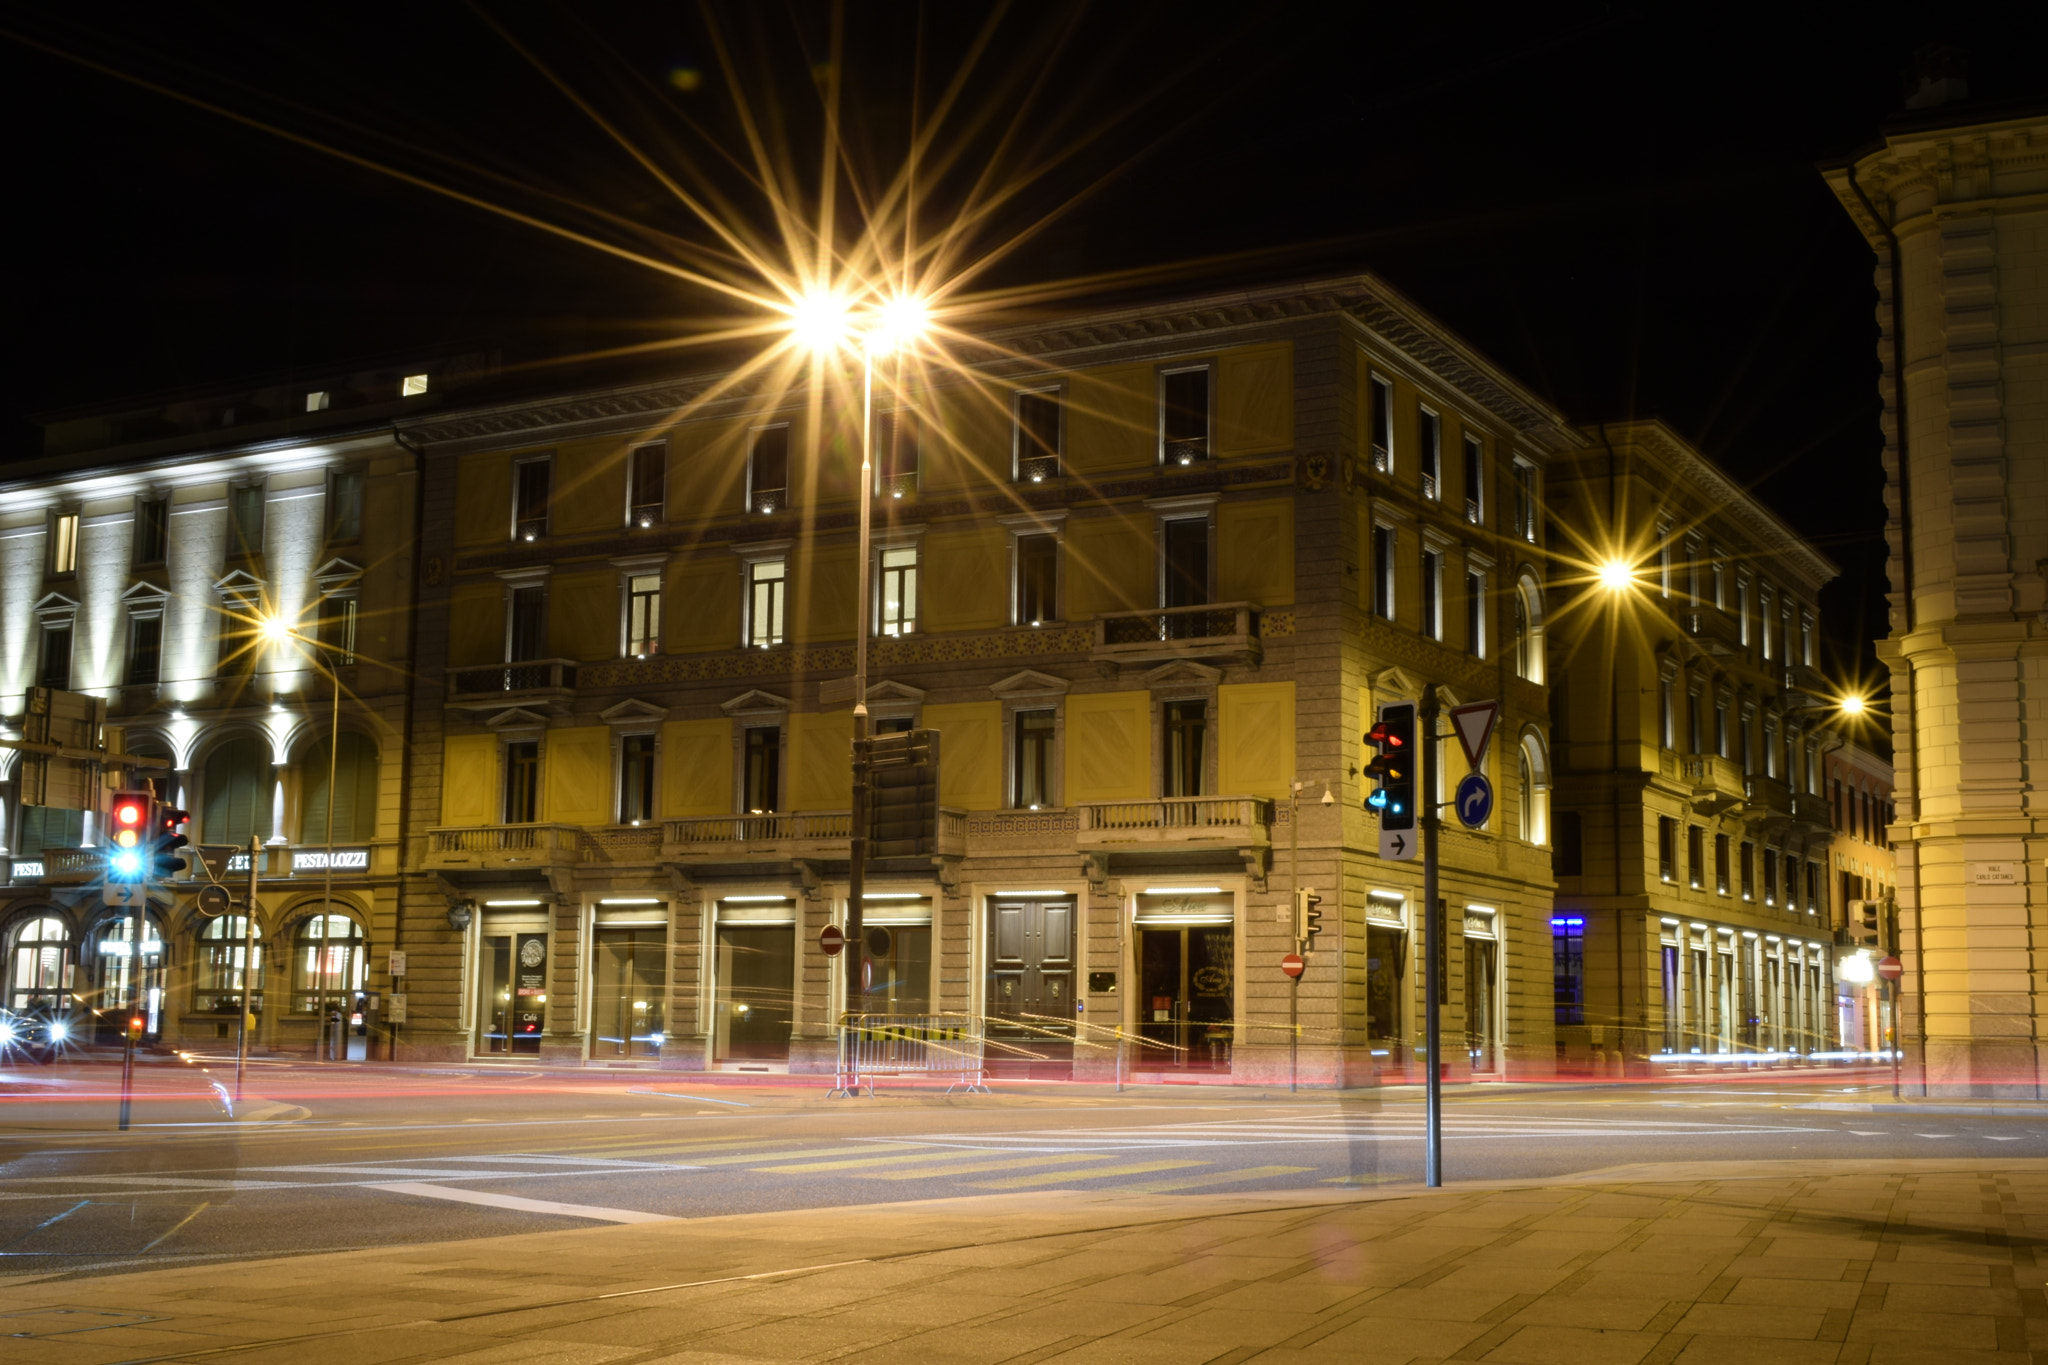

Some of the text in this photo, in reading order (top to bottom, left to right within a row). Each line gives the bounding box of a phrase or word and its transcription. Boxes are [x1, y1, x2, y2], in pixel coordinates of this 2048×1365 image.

[294, 852, 367, 868] PESTALOZZI
[13, 862, 45, 877] PESTA
[1988, 865, 2001, 873] VIALE
